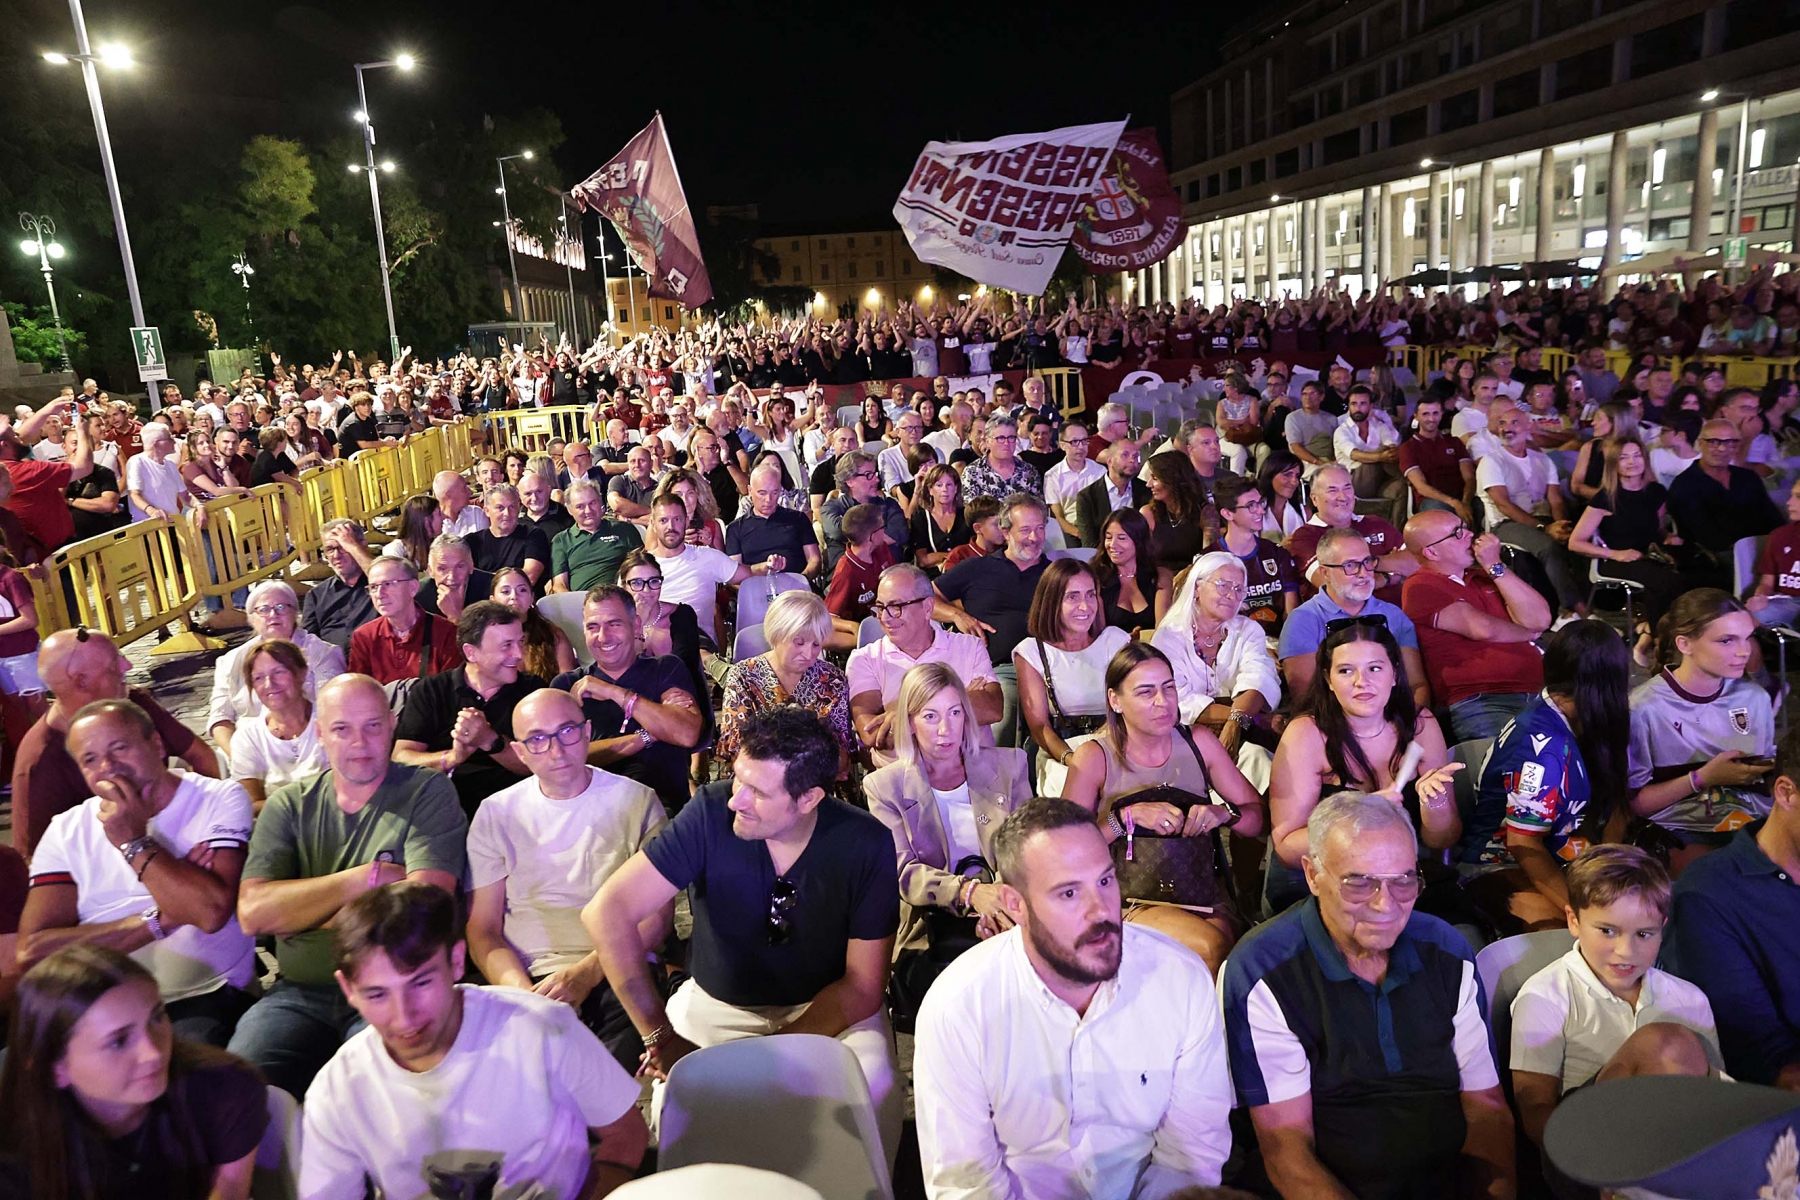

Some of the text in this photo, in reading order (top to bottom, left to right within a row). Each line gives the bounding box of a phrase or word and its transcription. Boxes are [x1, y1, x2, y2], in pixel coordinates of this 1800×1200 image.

[1100, 200, 1132, 215] Q R
[1108, 227, 1141, 244] 1991
[1131, 215, 1180, 266] EMILIA
[1246, 579, 1282, 597] ERGAS
